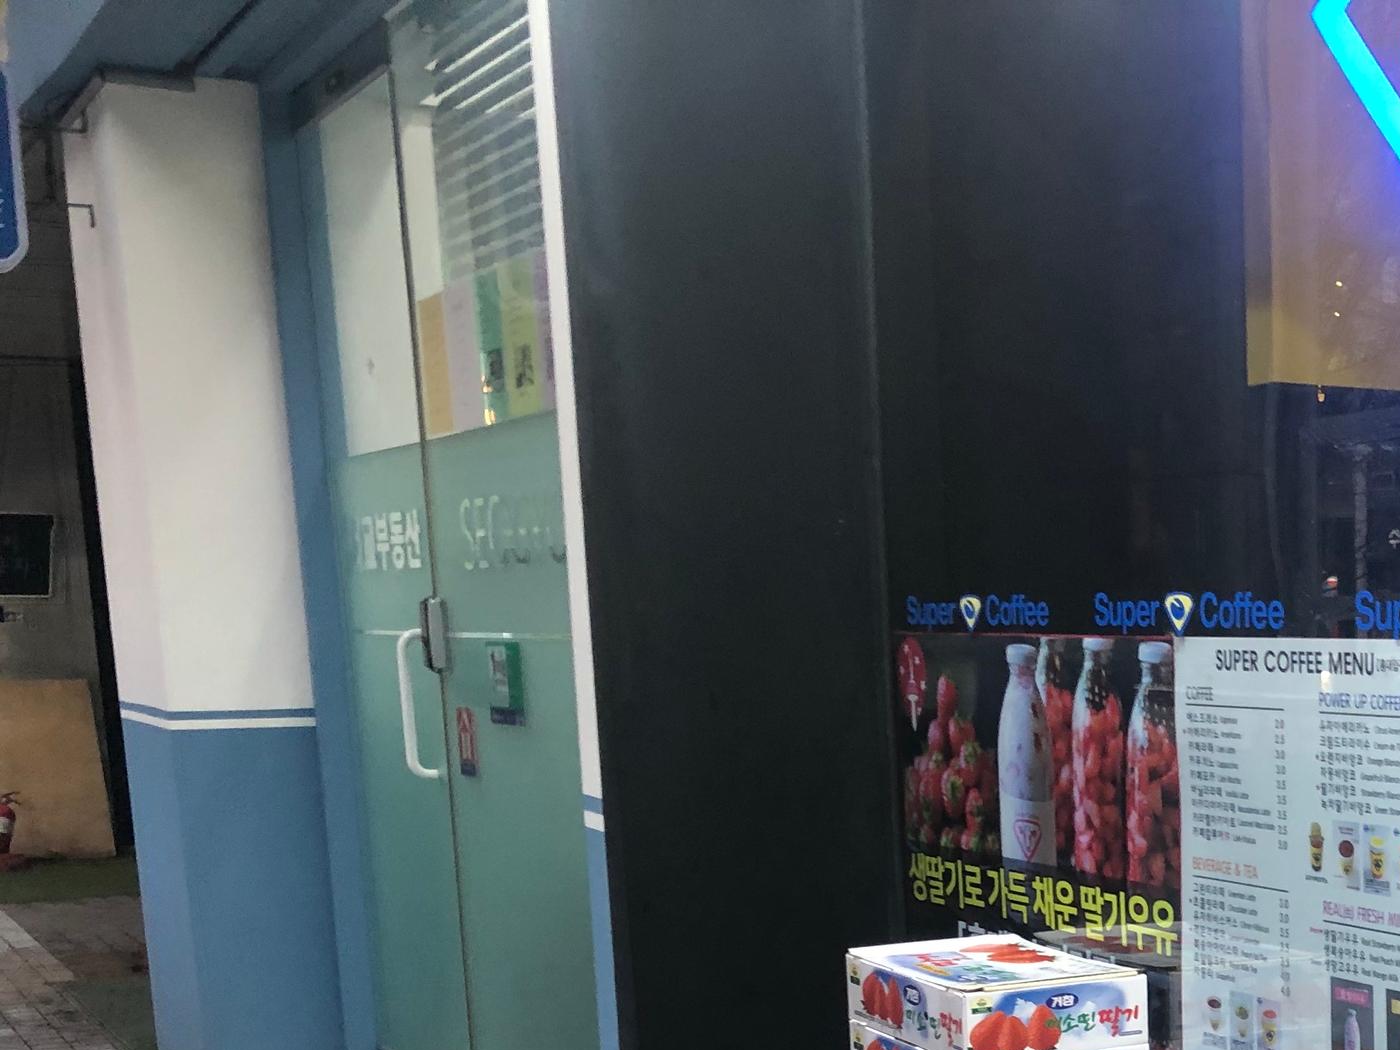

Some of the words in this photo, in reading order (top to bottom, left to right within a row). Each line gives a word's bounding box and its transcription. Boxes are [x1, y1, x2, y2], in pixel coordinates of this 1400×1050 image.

[907, 596, 956, 630] Super
[986, 595, 1050, 627] Coffee
[1094, 592, 1160, 634] Super
[1200, 591, 1284, 630] Coffee
[1216, 650, 1258, 672] SUPER
[1264, 651, 1322, 674] COFFEE
[1328, 652, 1374, 675] MENU
[1186, 686, 1213, 701] COFFEE
[1319, 692, 1350, 708] POWER
[1355, 694, 1367, 709] UP
[909, 853, 985, 908] 생딸기로
[987, 868, 1029, 924] 가득
[1031, 876, 1078, 933] 채운
[1080, 887, 1178, 956] 딸기우유
[1098, 1005, 1139, 1037] 딸기
